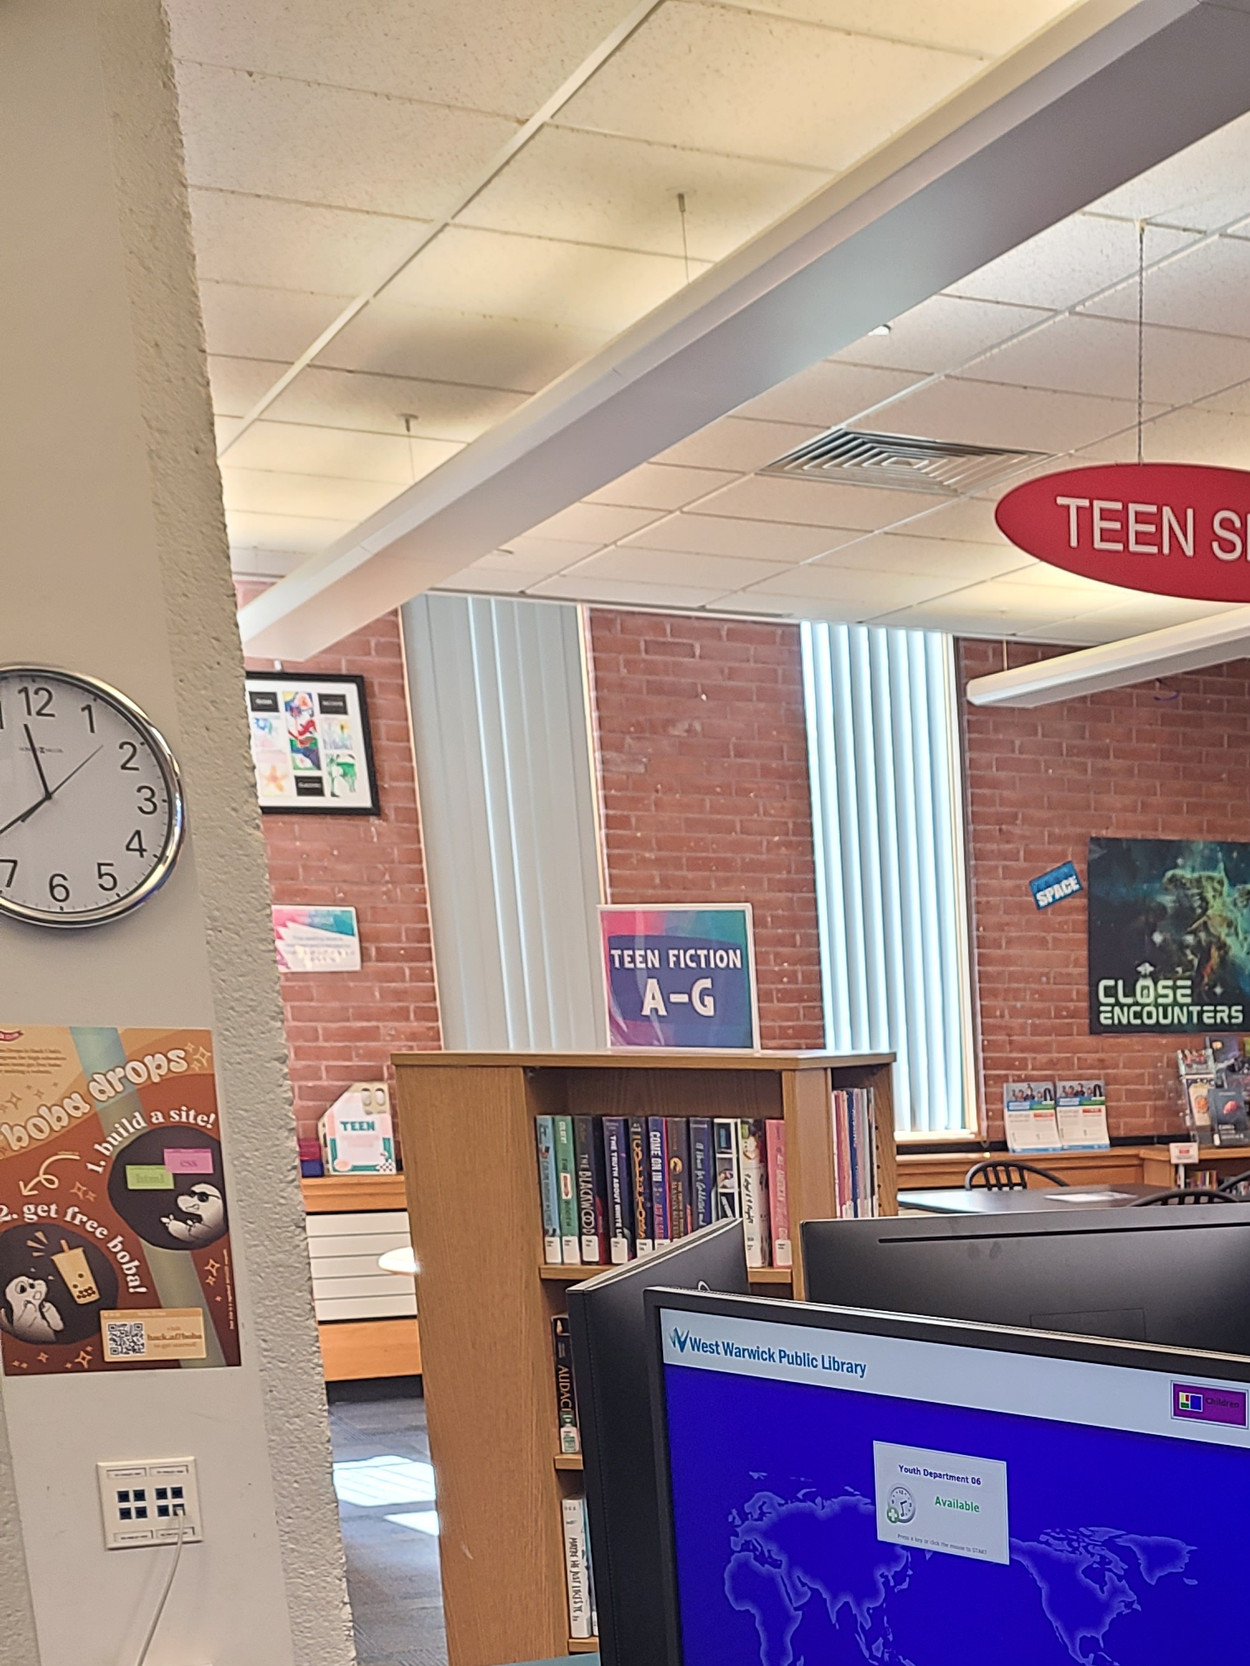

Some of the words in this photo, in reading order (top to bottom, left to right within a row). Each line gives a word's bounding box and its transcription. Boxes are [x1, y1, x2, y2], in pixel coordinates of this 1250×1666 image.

[1056, 496, 1195, 557] TEEN
[18, 686, 55, 718] 12
[81, 704, 95, 733] 1
[119, 741, 140, 771] 2
[136, 786, 158, 815] 3
[125, 829, 148, 859] 4
[48, 873, 70, 902] 6
[96, 862, 118, 891] 5
[1036, 875, 1080, 907] SPACE
[611, 949, 660, 969] TEEN
[668, 949, 742, 969] FICTION
[1098, 979, 1192, 1004] CLOSE
[1099, 1005, 1244, 1025] ENCOUNTERS
[2, 1090, 91, 1151] boba
[88, 1049, 189, 1100] drops
[102, 1112, 148, 1158] build
[150, 1110, 165, 1125] a
[169, 1106, 217, 1129] site!
[340, 1121, 375, 1132] TEEN
[610, 1135, 618, 1150] THE
[649, 1132, 662, 1154] COME
[580, 1154, 589, 1168] THE
[611, 1152, 619, 1176] TRUTH
[651, 1158, 662, 1170] ON
[613, 1178, 621, 1203] ABOUT
[652, 1172, 662, 1182] IN
[22, 1202, 59, 1223] get
[63, 1205, 109, 1240] free
[106, 1234, 149, 1294] boba!
[689, 1337, 720, 1355] West
[722, 1342, 776, 1363] Warwick
[778, 1349, 818, 1368] Public
[821, 1354, 867, 1378] Library
[558, 1365, 572, 1411] AUDACI
[898, 1465, 921, 1476] Youth
[923, 1469, 969, 1483] Department
[971, 1477, 981, 1485] 06
[935, 1496, 980, 1512] Available
